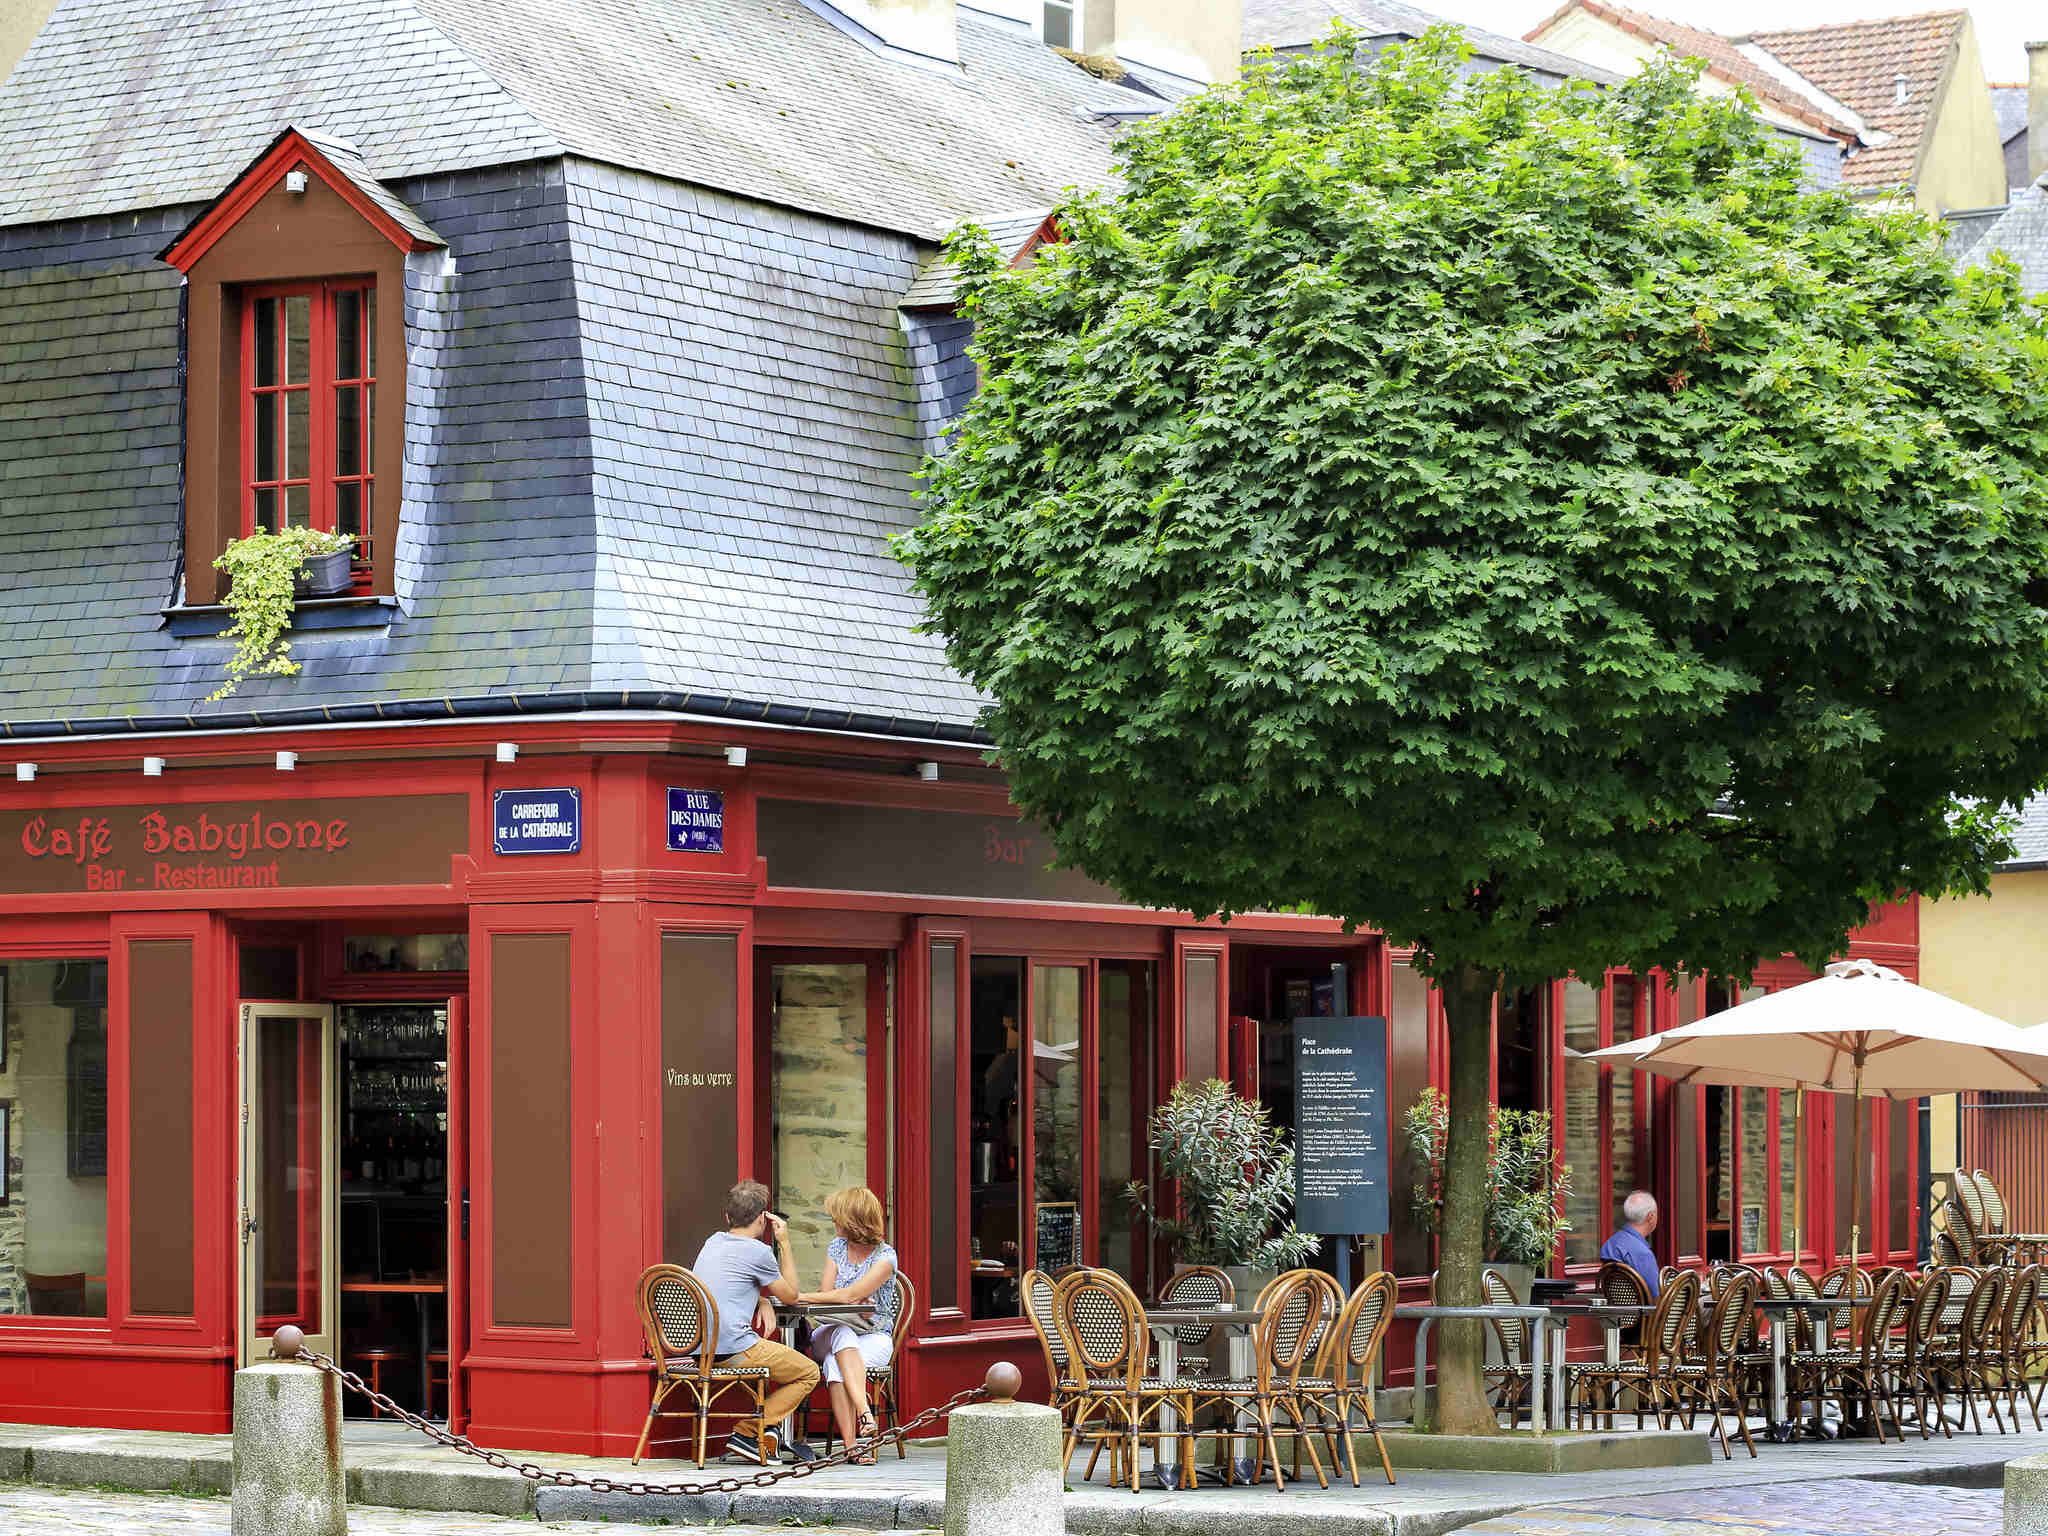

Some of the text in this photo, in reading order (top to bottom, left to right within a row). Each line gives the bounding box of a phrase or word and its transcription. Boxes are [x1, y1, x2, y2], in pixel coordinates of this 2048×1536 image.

[512, 803, 559, 819] CARREFOUR
[687, 794, 710, 810] RUE
[499, 818, 572, 839] DE LA CATHÉDRALE
[671, 810, 723, 829] DES DAMES
[21, 809, 350, 864] Café Babylone
[983, 824, 1033, 865] Bar
[86, 864, 127, 891] Bar
[154, 860, 281, 889] Restaurant
[1302, 1038, 1316, 1047] Place
[1302, 1047, 1352, 1055] de la Cathédrale
[667, 1068, 732, 1088] Vins au verre
